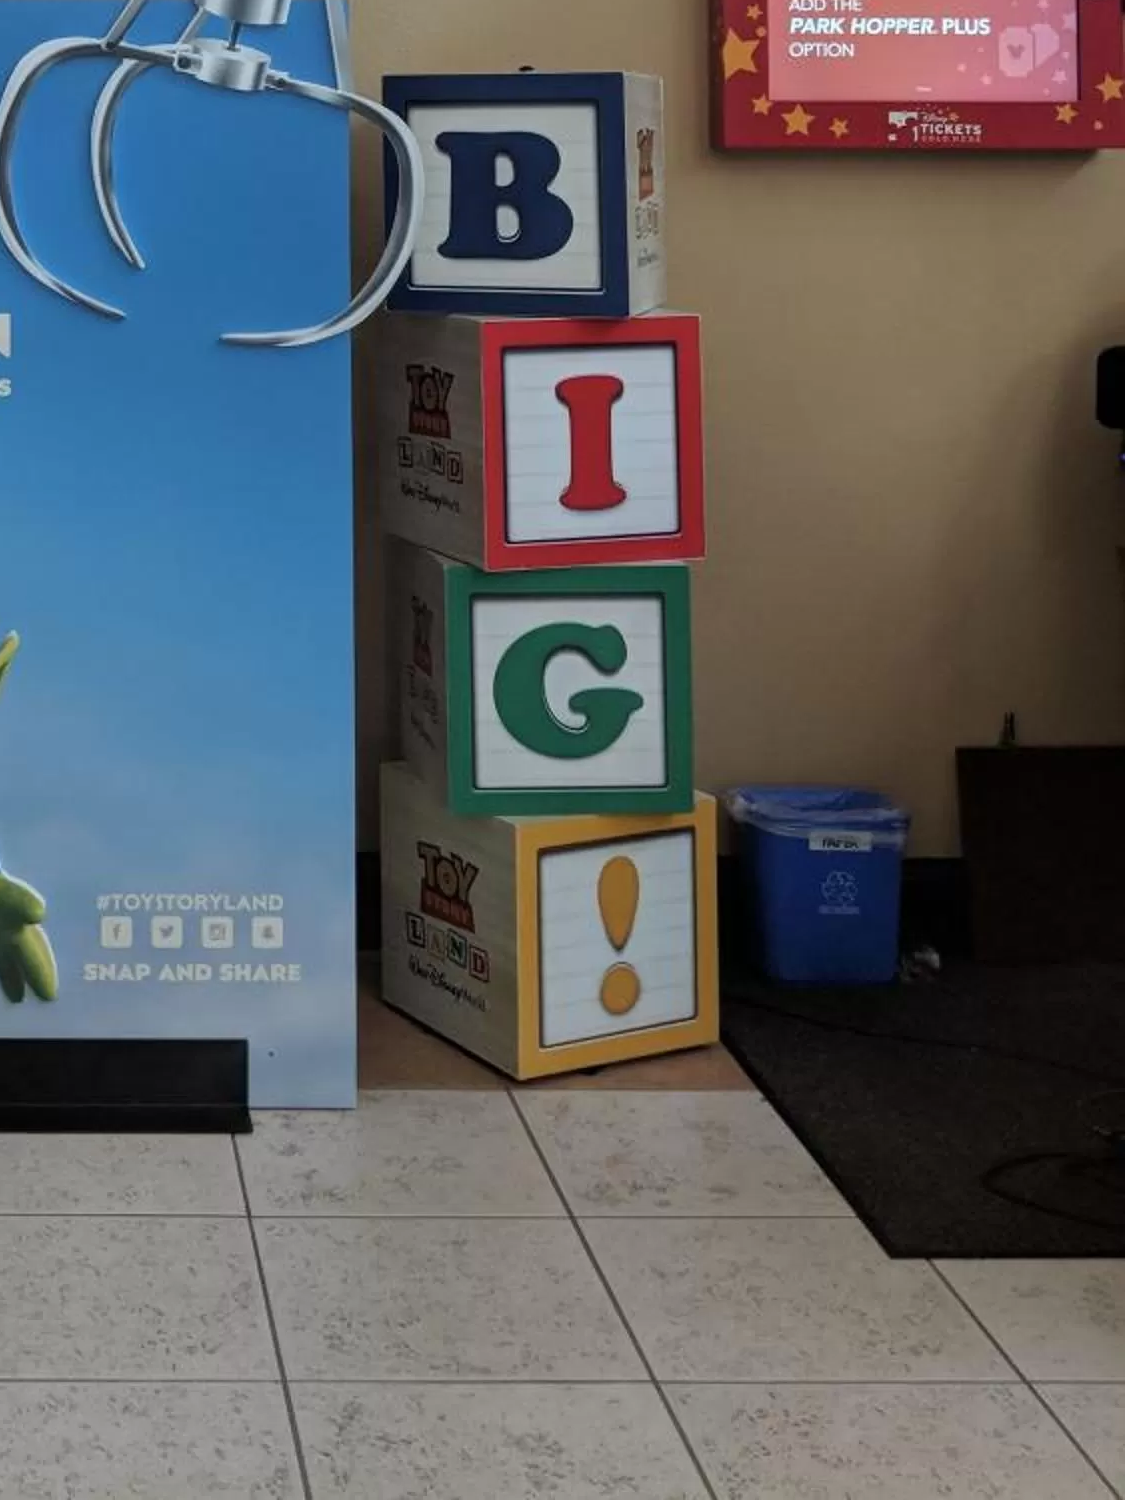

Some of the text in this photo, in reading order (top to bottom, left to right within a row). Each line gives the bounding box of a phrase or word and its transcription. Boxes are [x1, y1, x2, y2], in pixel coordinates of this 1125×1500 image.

[789, 17, 846, 35] PARK
[941, 17, 991, 35] PLUS
[788, 41, 855, 57] OPTION
[921, 124, 982, 134] TICKETS
[406, 364, 455, 412] TOY
[417, 841, 480, 905] TOY
[96, 894, 284, 912] #TOYSTORYLAND
[83, 963, 302, 981] SNAP AND SHARE
